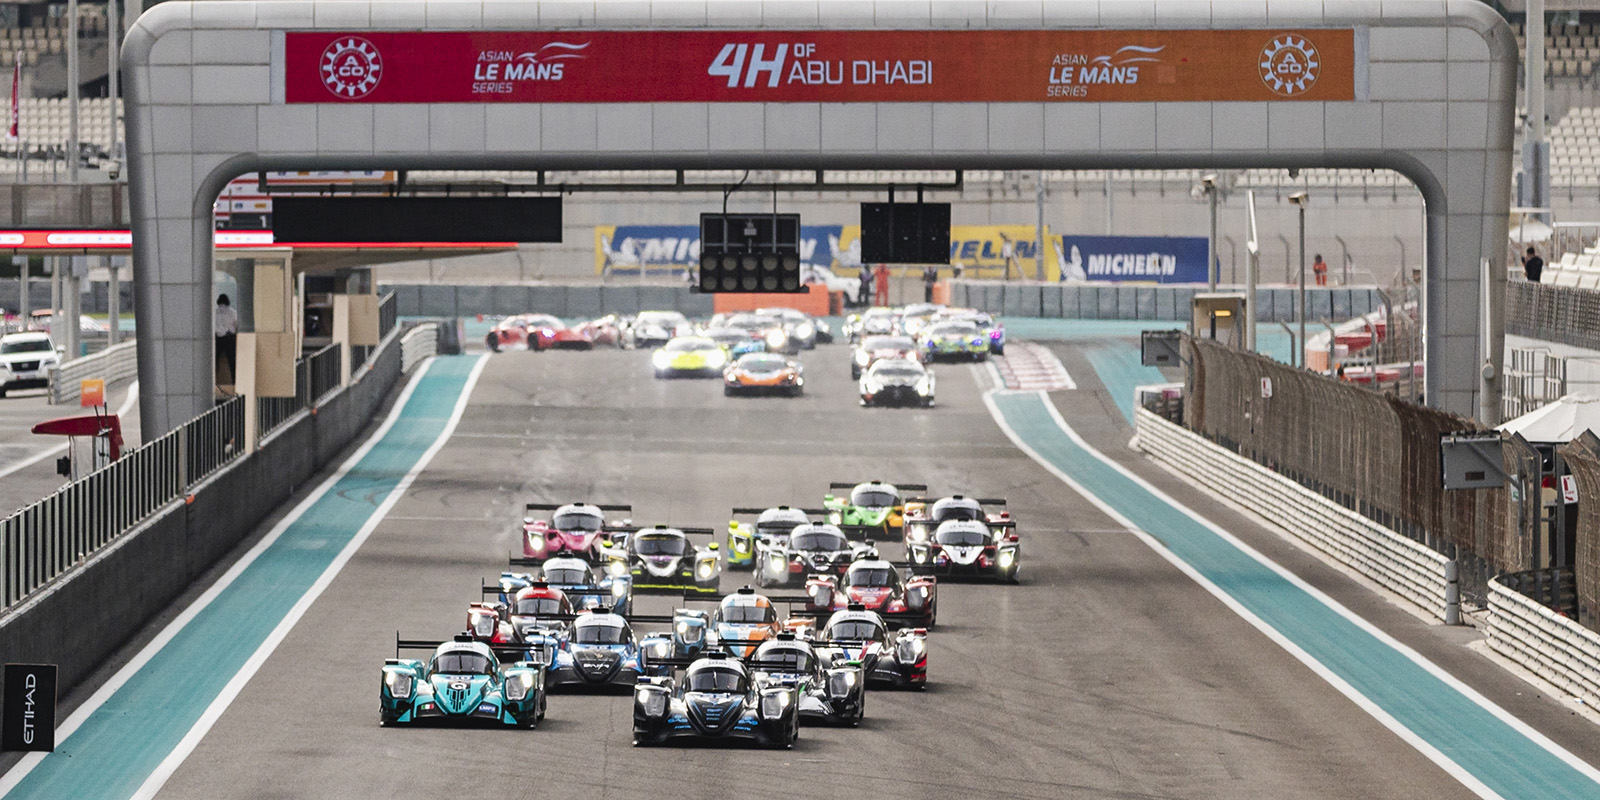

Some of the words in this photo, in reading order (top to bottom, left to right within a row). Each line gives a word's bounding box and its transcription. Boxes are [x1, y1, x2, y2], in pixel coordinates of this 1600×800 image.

[477, 50, 514, 61] ASIAN
[793, 43, 816, 57] OF
[708, 43, 788, 87] 4H
[1052, 54, 1088, 65] ASIAN
[474, 63, 499, 80] LE
[504, 63, 564, 80] MANS
[787, 60, 843, 84] ABU
[852, 60, 932, 84] DHABI
[1049, 66, 1074, 84] LE
[1079, 66, 1139, 84] MANS
[472, 82, 514, 93] SERIES
[1047, 85, 1088, 97] SERIES
[23, 673, 37, 744] ETIHAD
